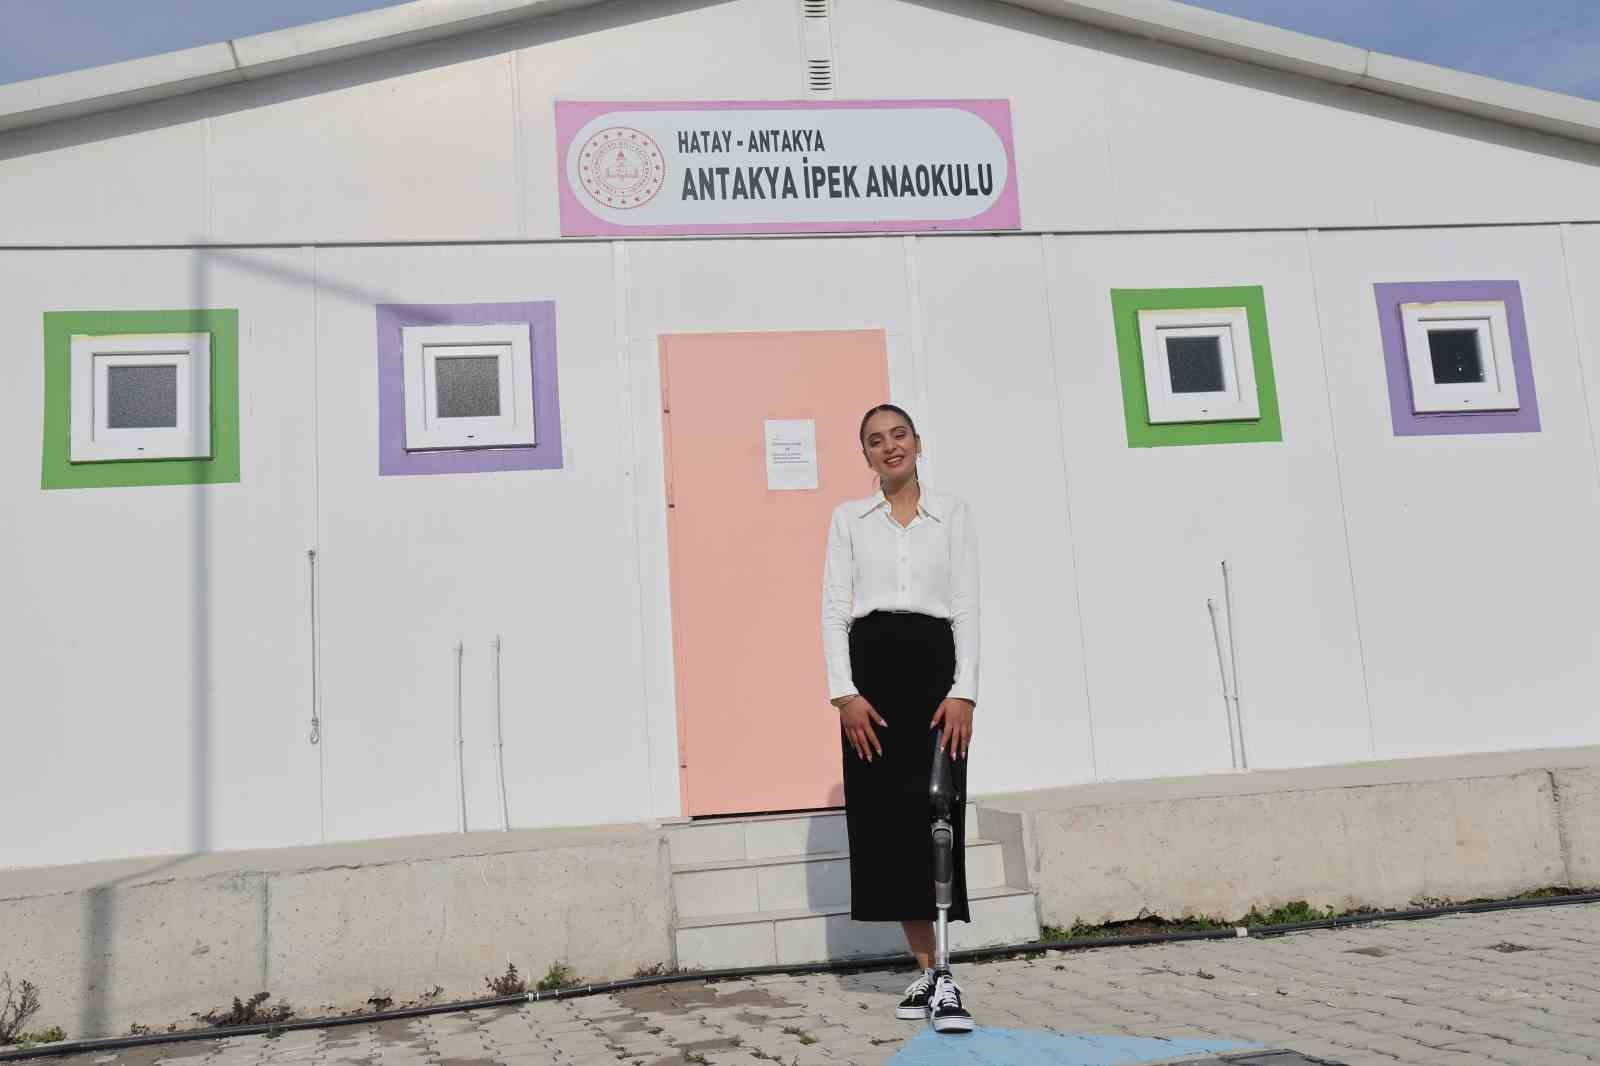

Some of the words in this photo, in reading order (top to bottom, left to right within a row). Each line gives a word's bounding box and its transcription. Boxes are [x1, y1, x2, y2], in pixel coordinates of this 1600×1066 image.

[678, 130, 732, 154] HATAY
[748, 129, 826, 153] ANTAKYA
[682, 166, 799, 201] ANTAKYA
[802, 156, 861, 199] İPEK
[865, 163, 994, 198] ANAOKULU
